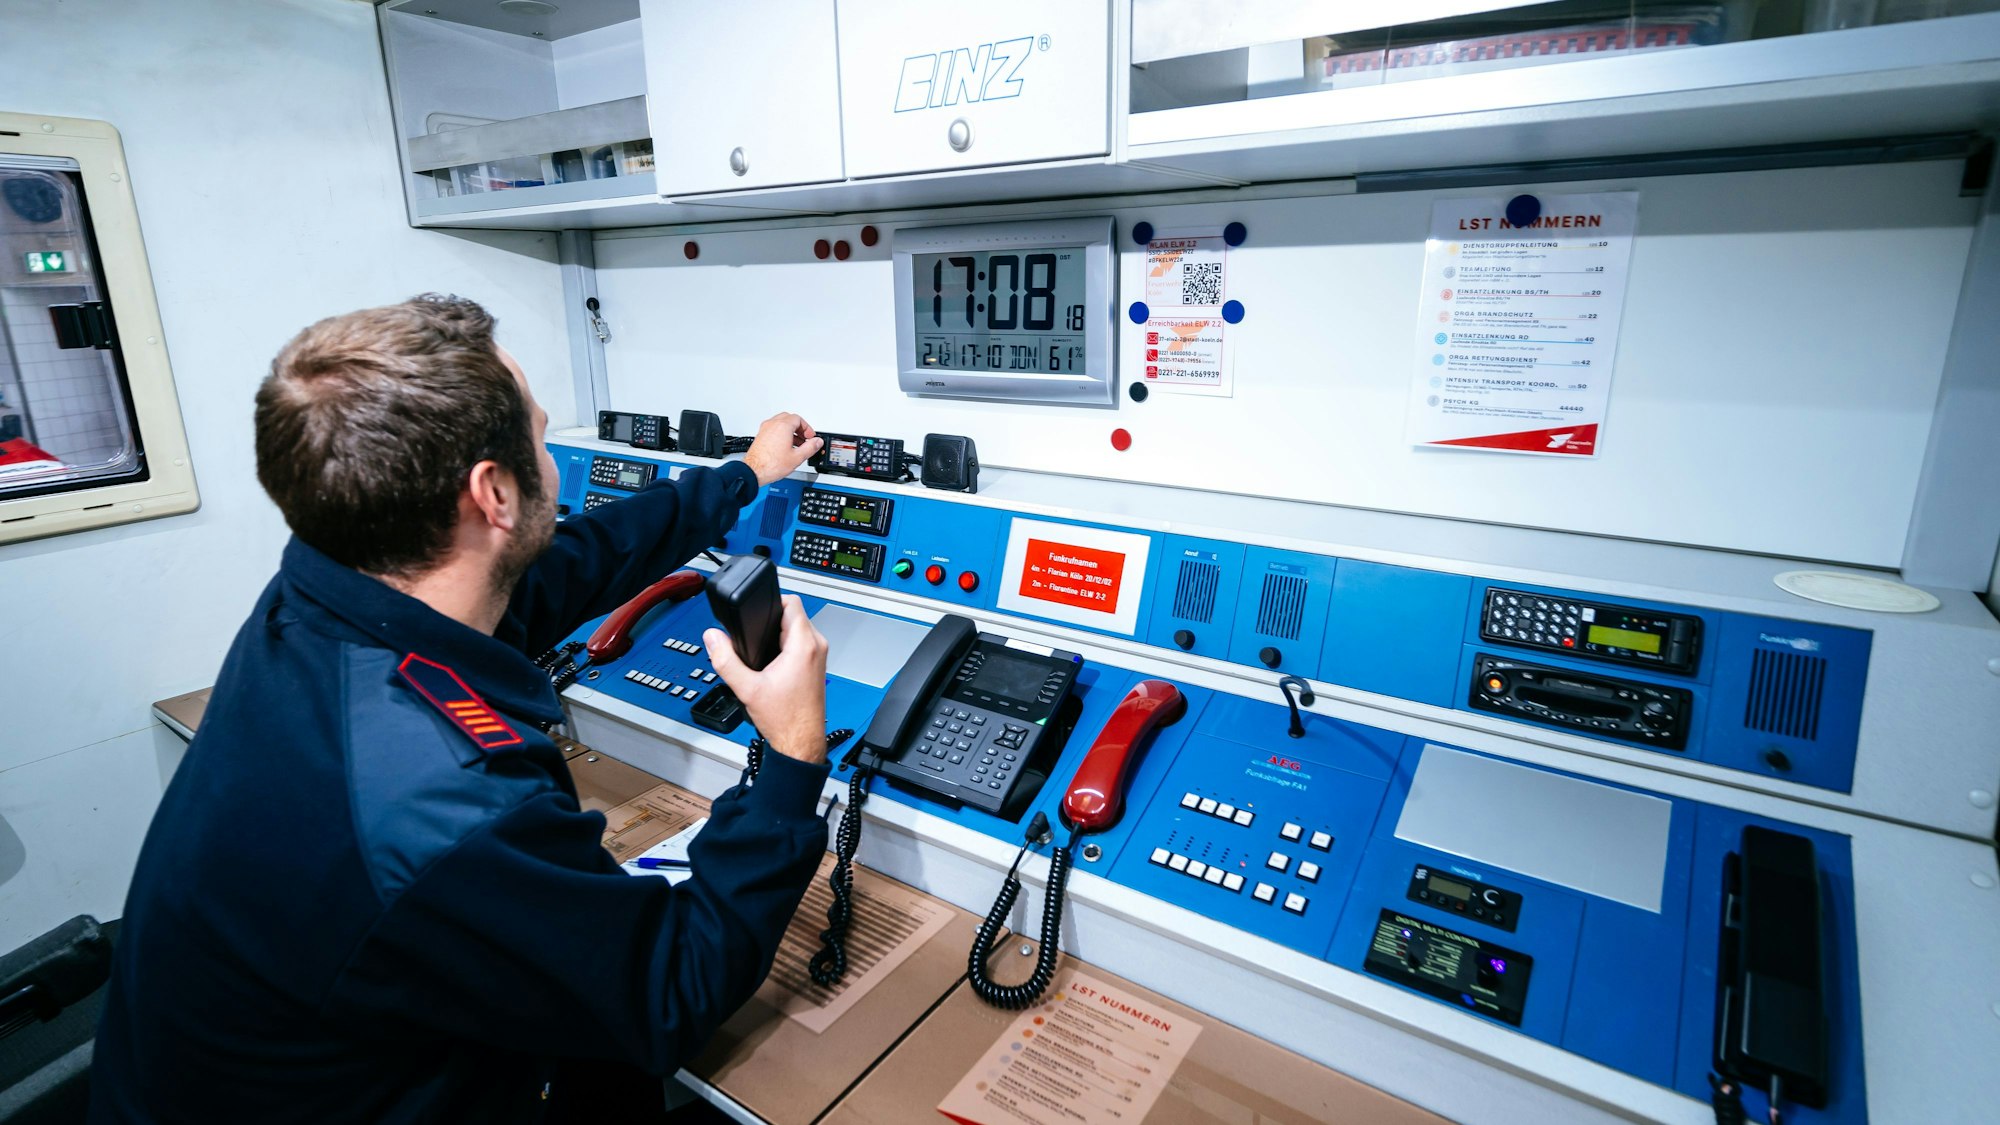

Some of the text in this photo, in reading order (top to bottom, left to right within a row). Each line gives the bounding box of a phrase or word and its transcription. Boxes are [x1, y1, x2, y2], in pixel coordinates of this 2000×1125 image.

[1459, 215, 1601, 230] LST NMMERN
[933, 253, 1057, 331] 17:08
[1066, 304, 1084, 331] 18
[1148, 319, 1222, 328] Erreichbarkeit ELW 2.2
[1472, 355, 1538, 363] RETTUNGSDIENST
[1158, 368, 1220, 378] 0221-221-6569939
[1049, 552, 1098, 569] Funkrufnamen
[1031, 564, 1040, 572] 4m
[1047, 567, 1068, 577] Florian
[1069, 571, 1083, 580] Köln
[1085, 574, 1112, 586] 20/12/02
[1032, 579, 1041, 587] 2m
[1049, 583, 1078, 595] Florentine
[1080, 589, 1094, 598] ELW
[1095, 592, 1106, 601] 2-2
[1267, 755, 1301, 771] AEG
[1245, 768, 1291, 787] Funkabfrage
[1071, 982, 1172, 1032] LST NUMMERN
